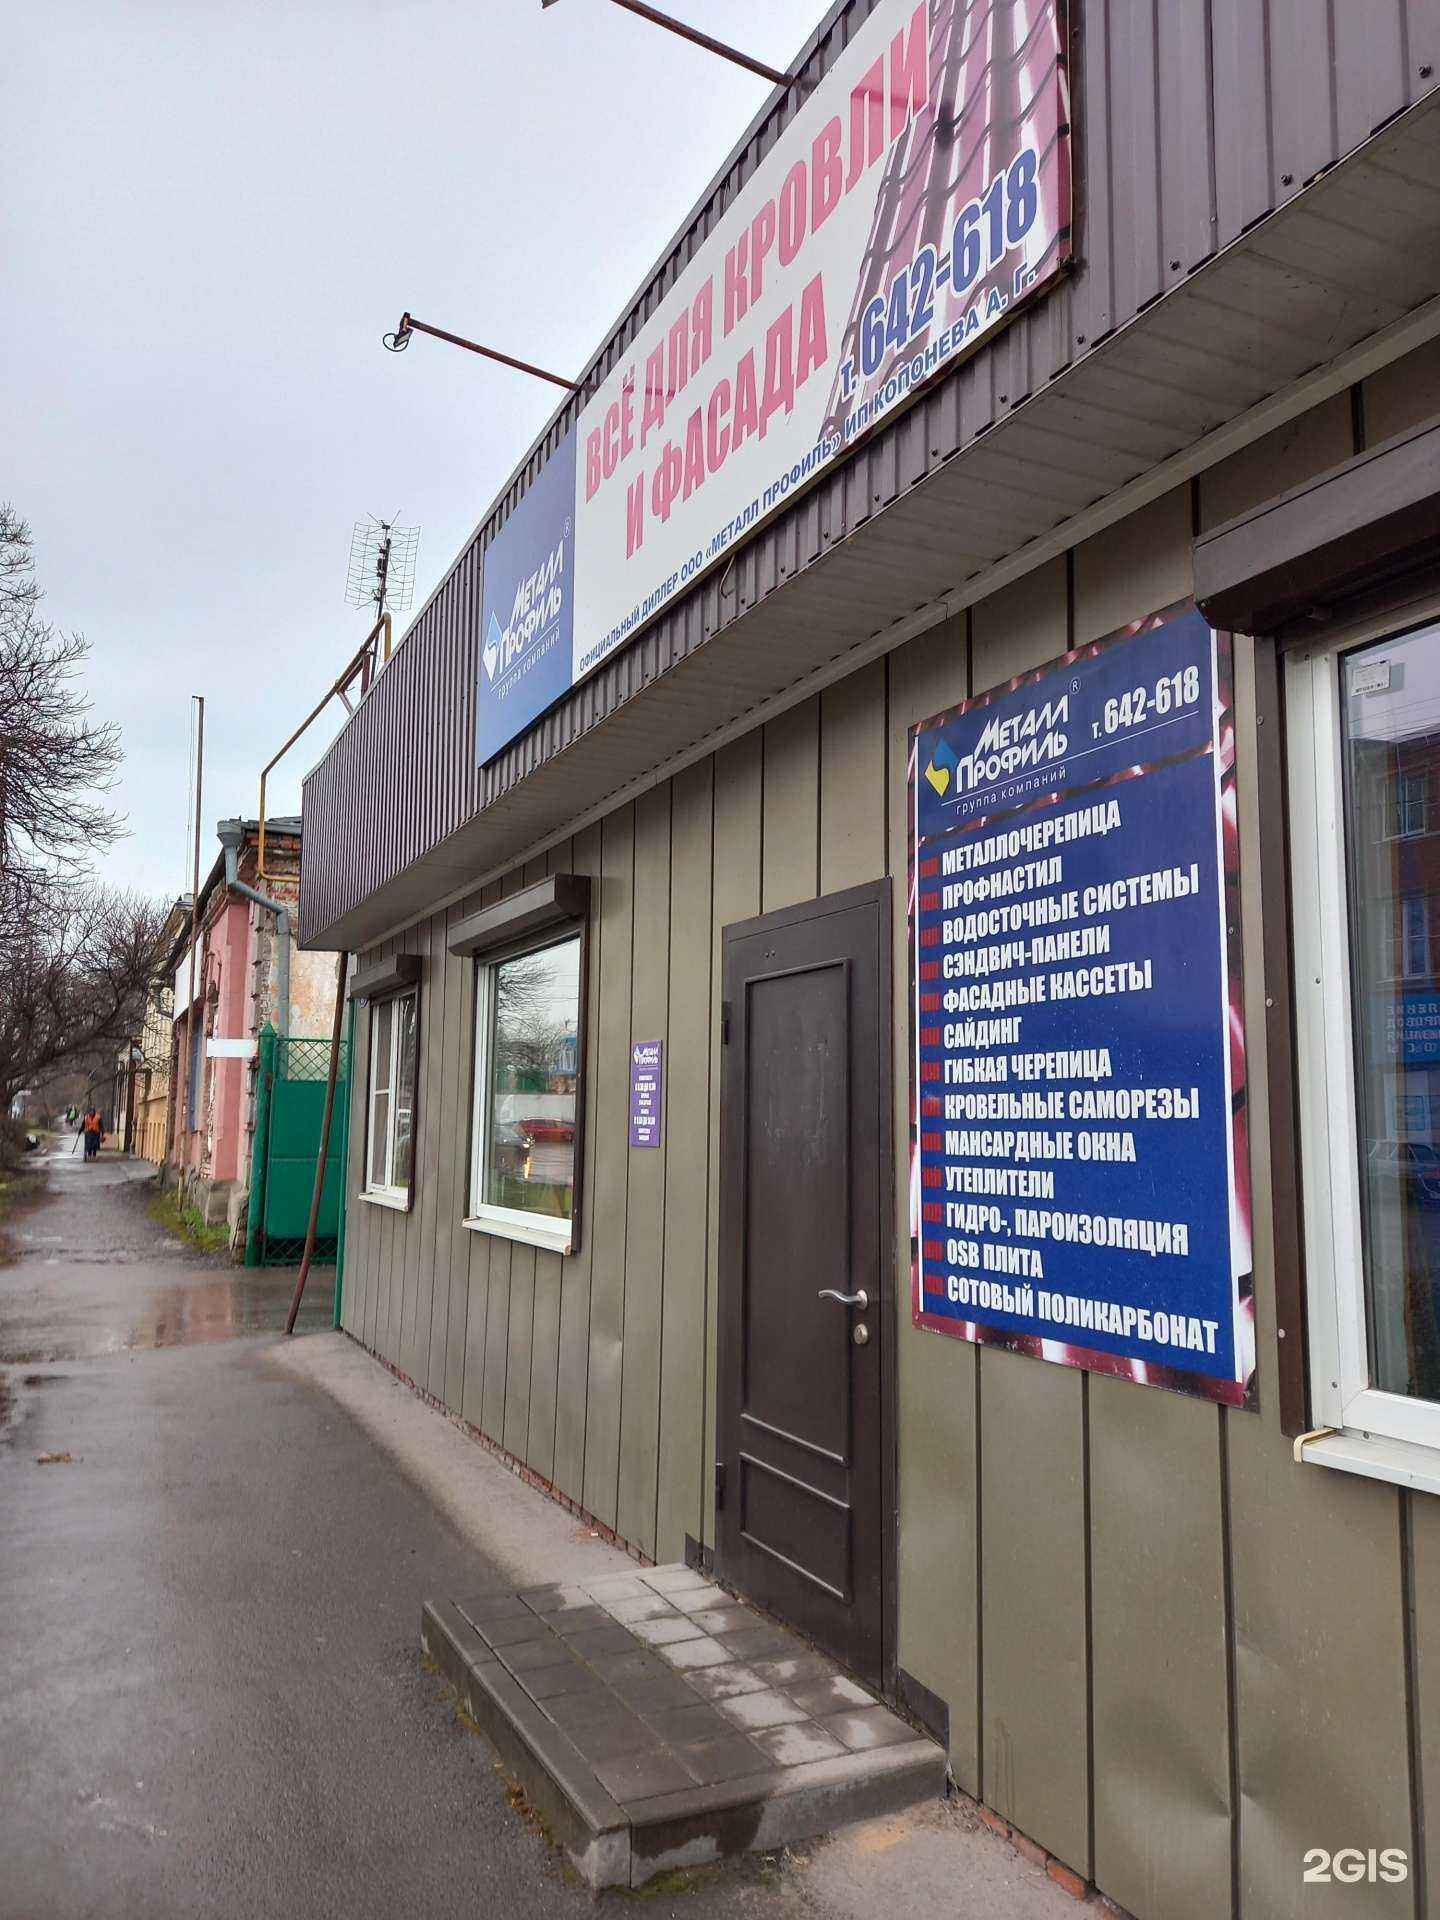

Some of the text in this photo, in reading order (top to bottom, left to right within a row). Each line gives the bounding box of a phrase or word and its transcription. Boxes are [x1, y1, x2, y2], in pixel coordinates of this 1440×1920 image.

[586, 2, 927, 504] ВСЁ ДЛЯ КРОВЛИ
[862, 148, 1037, 376] 642-618
[626, 272, 828, 560] И ФАСАДА
[579, 605, 640, 671] ОФИЦИАЛЬНЫЙ
[681, 550, 703, 581] ООО
[705, 499, 759, 559] «МЕТАЛЛ
[763, 433, 841, 511] ПРОФИЛЬ»
[846, 404, 869, 438] ИП
[986, 291, 1008, 319] А.
[974, 695, 1070, 758] МЕТАЛЛ
[1104, 665, 1200, 734] 642-618
[956, 729, 1068, 793] ПРОФИЛЬ
[956, 765, 1067, 815] группа компаний
[942, 800, 1122, 876] МЕТАЛЛОЧЕРЕПИЦА
[942, 856, 1062, 910] ПРОФНАСТИЛ
[942, 864, 1199, 945] ВОДОСТОЧНЫЕ СИСТЕМЫ
[943, 925, 1110, 979] СЭНДВИЧ-ПАНЕЛИ
[943, 960, 1153, 1013] ФАСАДНЫЕ КАССЕТЫ
[943, 1016, 1022, 1050] САЙДИНГ
[944, 1048, 1112, 1083] ГИБКАЯ ЧЕРЕПИЦА
[945, 1087, 1200, 1120] КРОВЕЛЬНЫЕ САМОРЕЗЫ
[945, 1130, 1136, 1162] МАНСАРДНЫЕ ОКНА
[945, 1166, 1054, 1199] УТЕПЛИТЕЛИ
[946, 1202, 1189, 1256] ГИДРО-, ПАРОИЗОЛЯЦИЯ
[946, 1238, 1043, 1279] OSB ПЛИТА
[947, 1275, 1219, 1354] СОТОВЫЙ ПОЛИКАРБОНАТ
